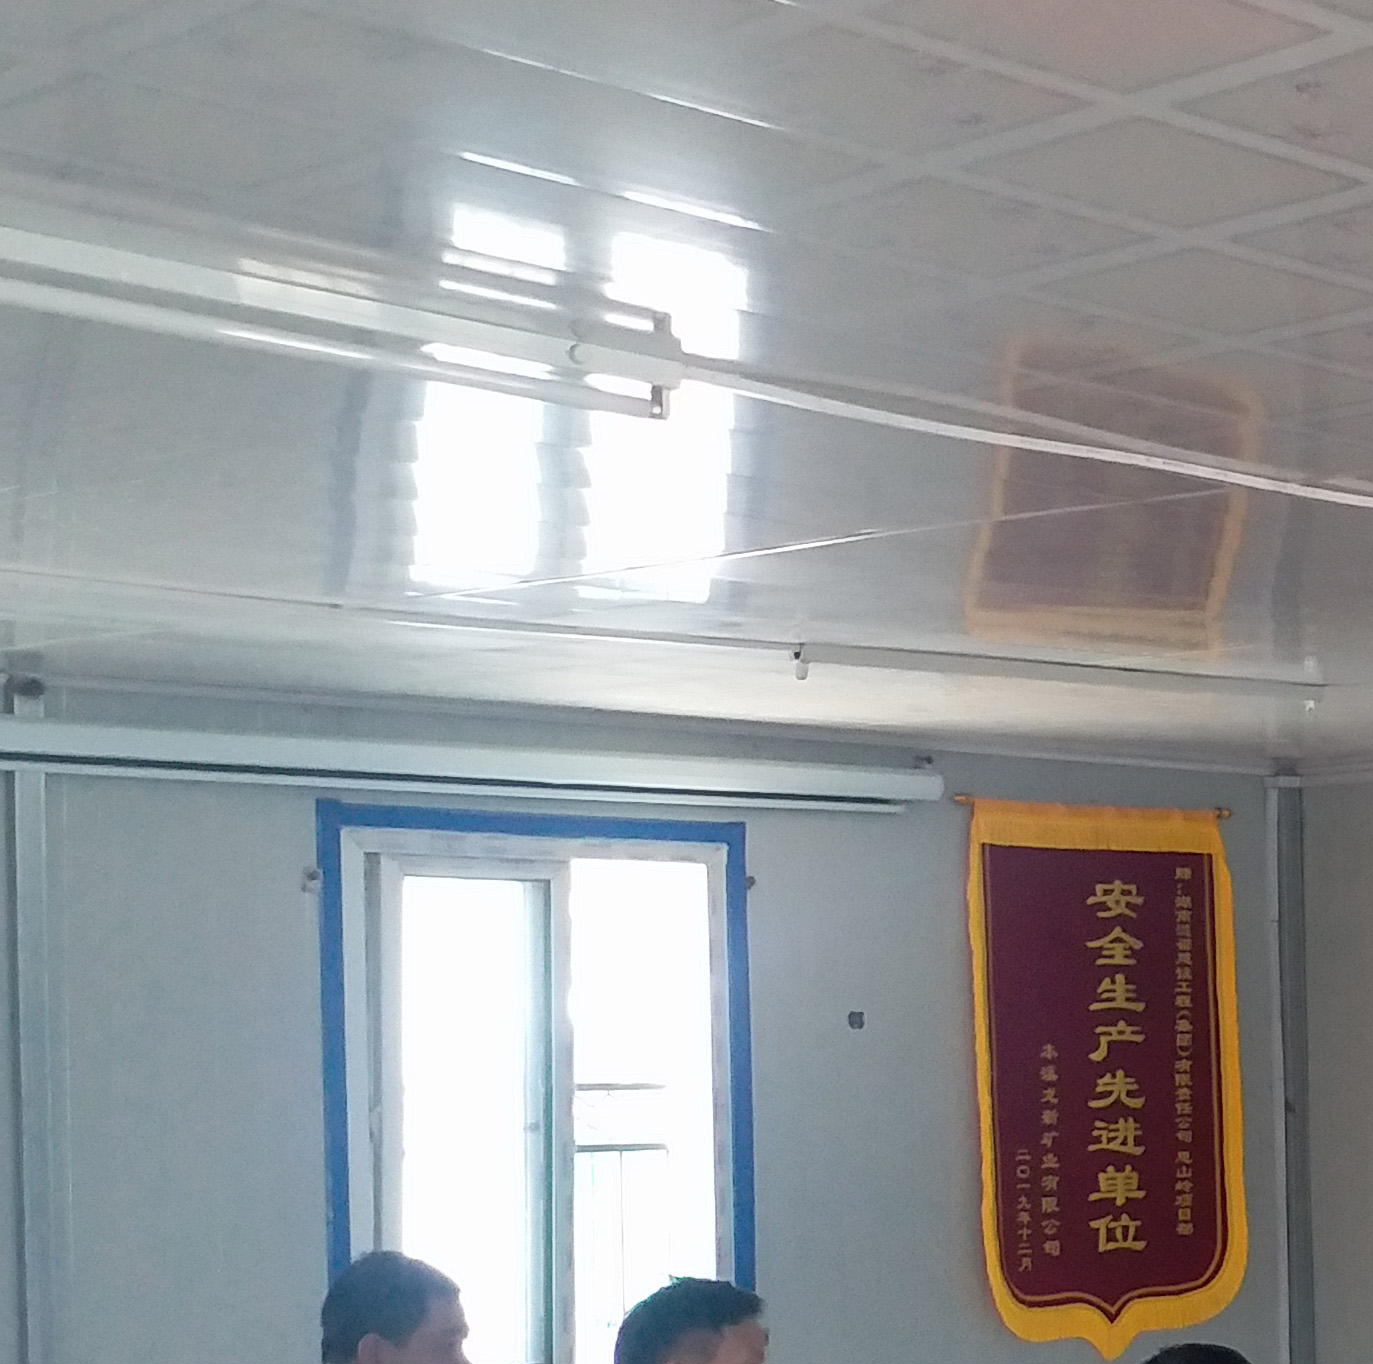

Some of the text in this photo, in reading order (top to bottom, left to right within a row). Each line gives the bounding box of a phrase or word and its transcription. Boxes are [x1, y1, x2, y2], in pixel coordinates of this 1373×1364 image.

[1086, 879, 1148, 1254] 安全生产先进单位
